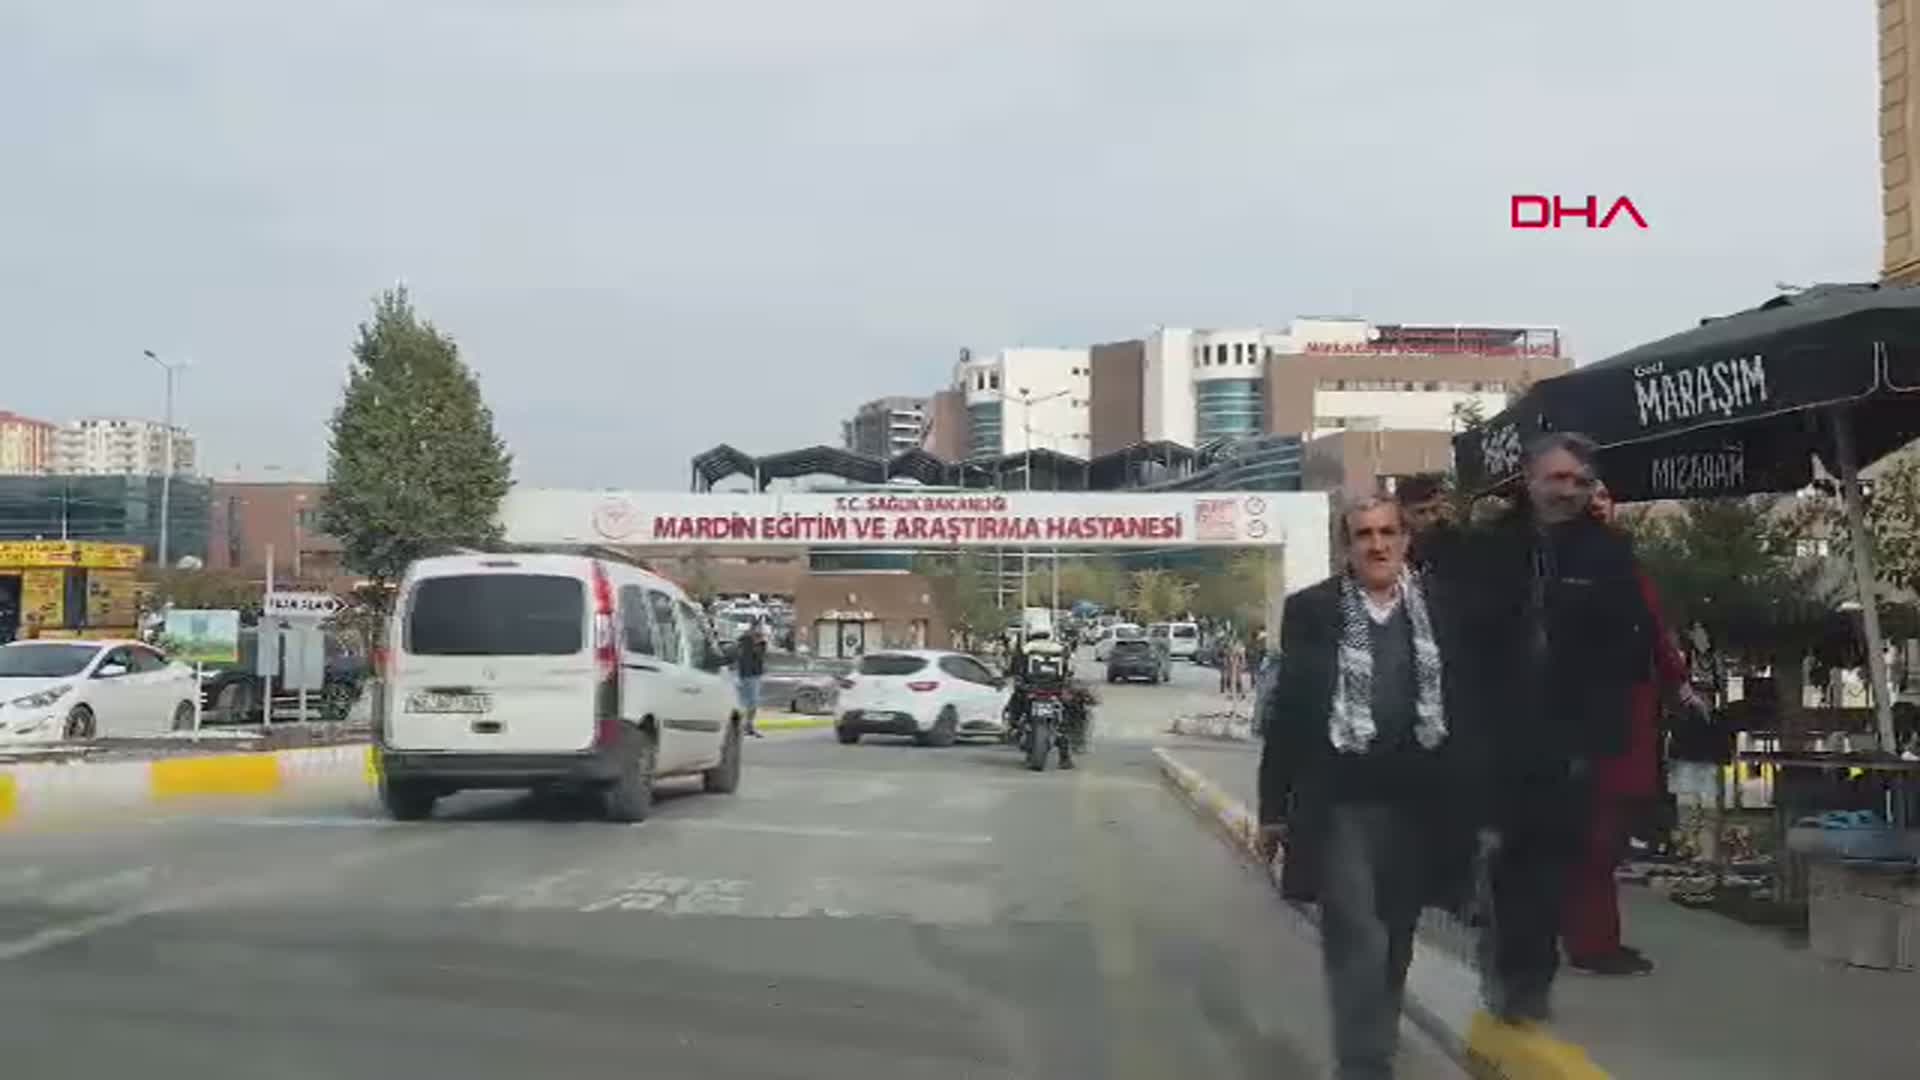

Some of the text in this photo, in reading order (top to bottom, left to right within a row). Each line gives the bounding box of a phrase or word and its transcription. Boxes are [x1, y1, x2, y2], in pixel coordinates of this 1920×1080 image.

[1635, 354, 1768, 426] MARAŞIM
[653, 511, 756, 539] MARDİN
[761, 511, 847, 539] EĞİTİM
[849, 516, 886, 538] VE
[893, 516, 1040, 544] ARAŞTIRMA
[1046, 512, 1183, 539] HASTANESİ
